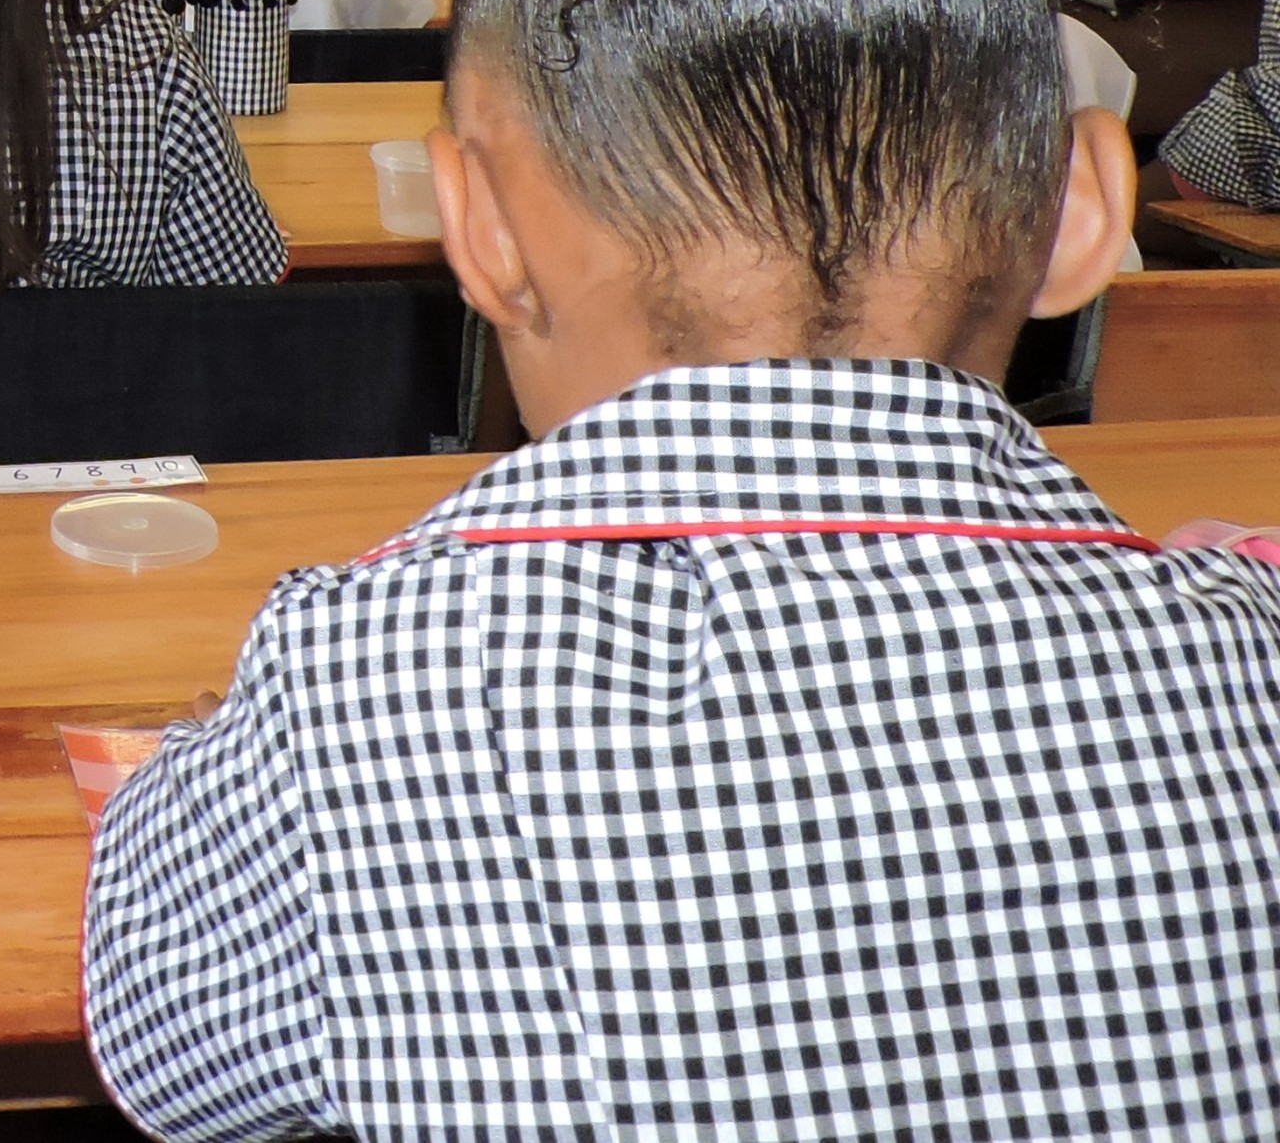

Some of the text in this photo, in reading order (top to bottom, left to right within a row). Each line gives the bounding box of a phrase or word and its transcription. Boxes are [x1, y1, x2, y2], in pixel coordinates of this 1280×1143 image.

[14, 469, 29, 480] 6
[49, 467, 62, 479] 7
[86, 465, 103, 477] 8
[120, 463, 137, 474] 9
[155, 460, 178, 473] 10
